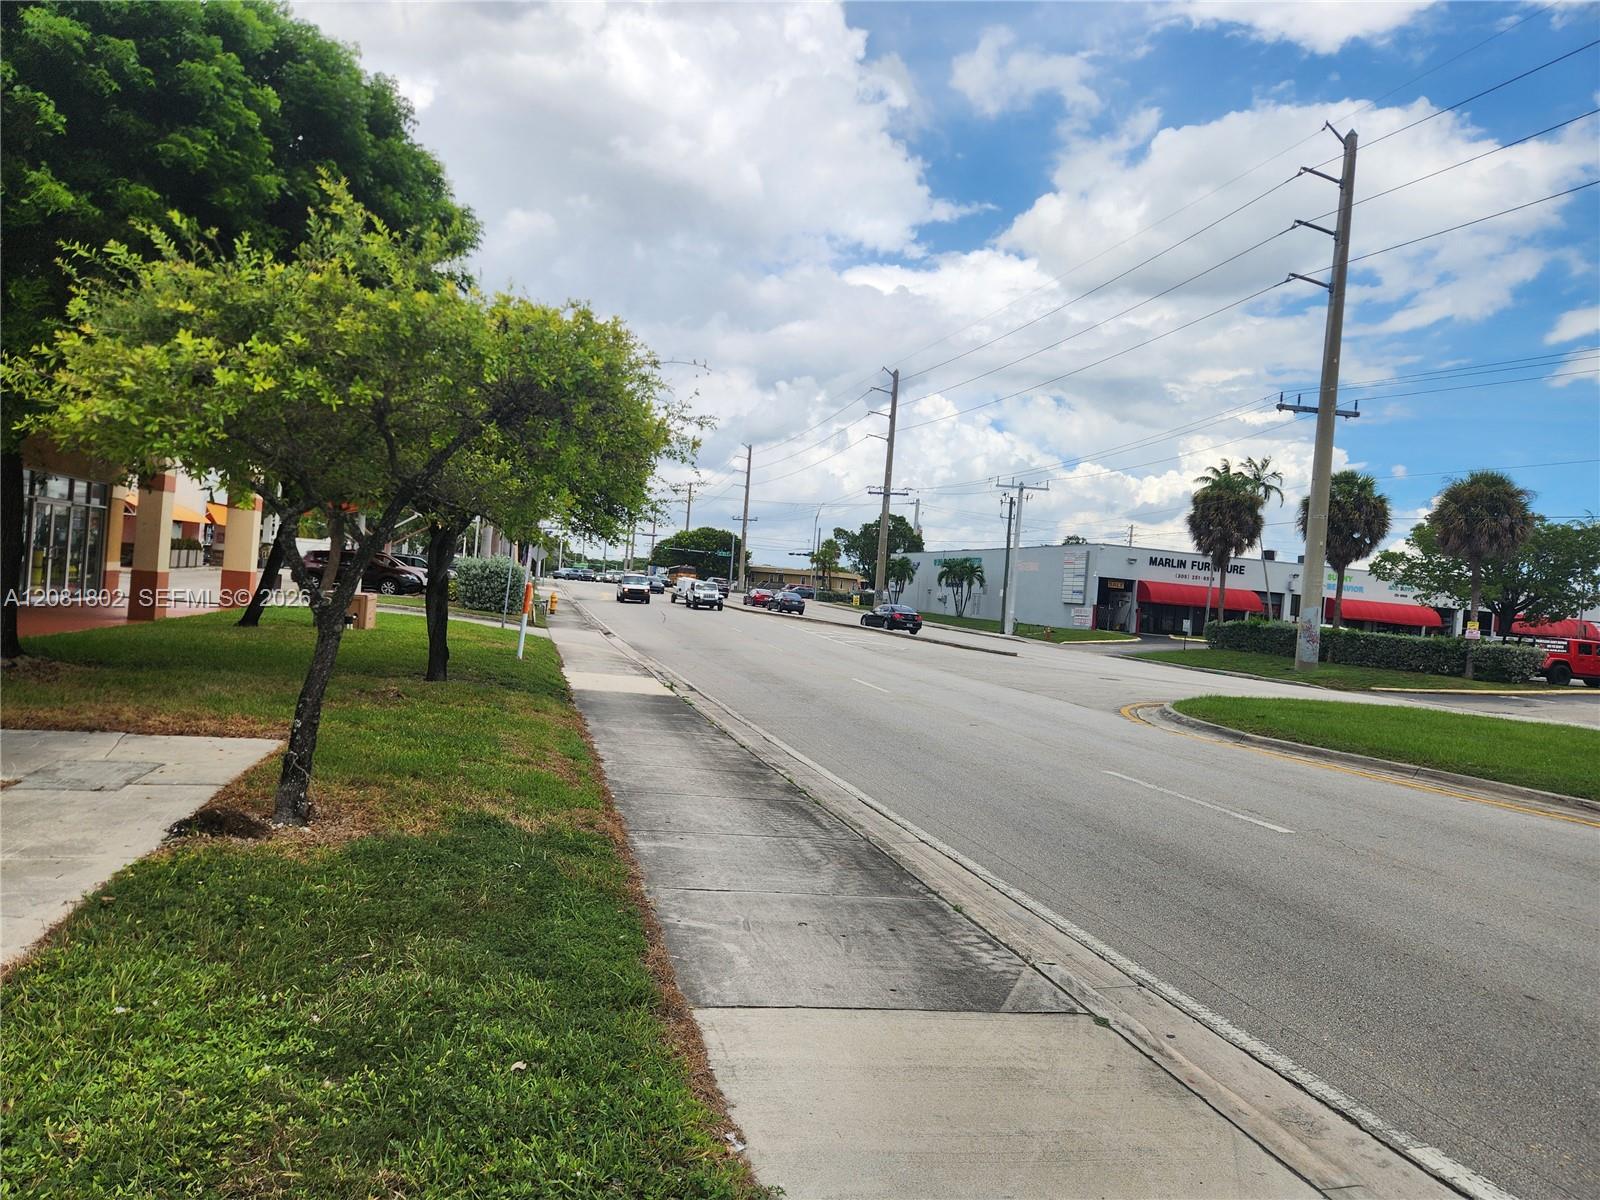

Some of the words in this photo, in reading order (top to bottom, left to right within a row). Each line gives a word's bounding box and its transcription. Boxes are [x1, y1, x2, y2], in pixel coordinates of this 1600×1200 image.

[1149, 557, 1187, 570] MARLIN
[1191, 560, 1246, 575] FURURE
[1328, 573, 1354, 582] SUNY
[1327, 583, 1365, 593] BEVIOR
